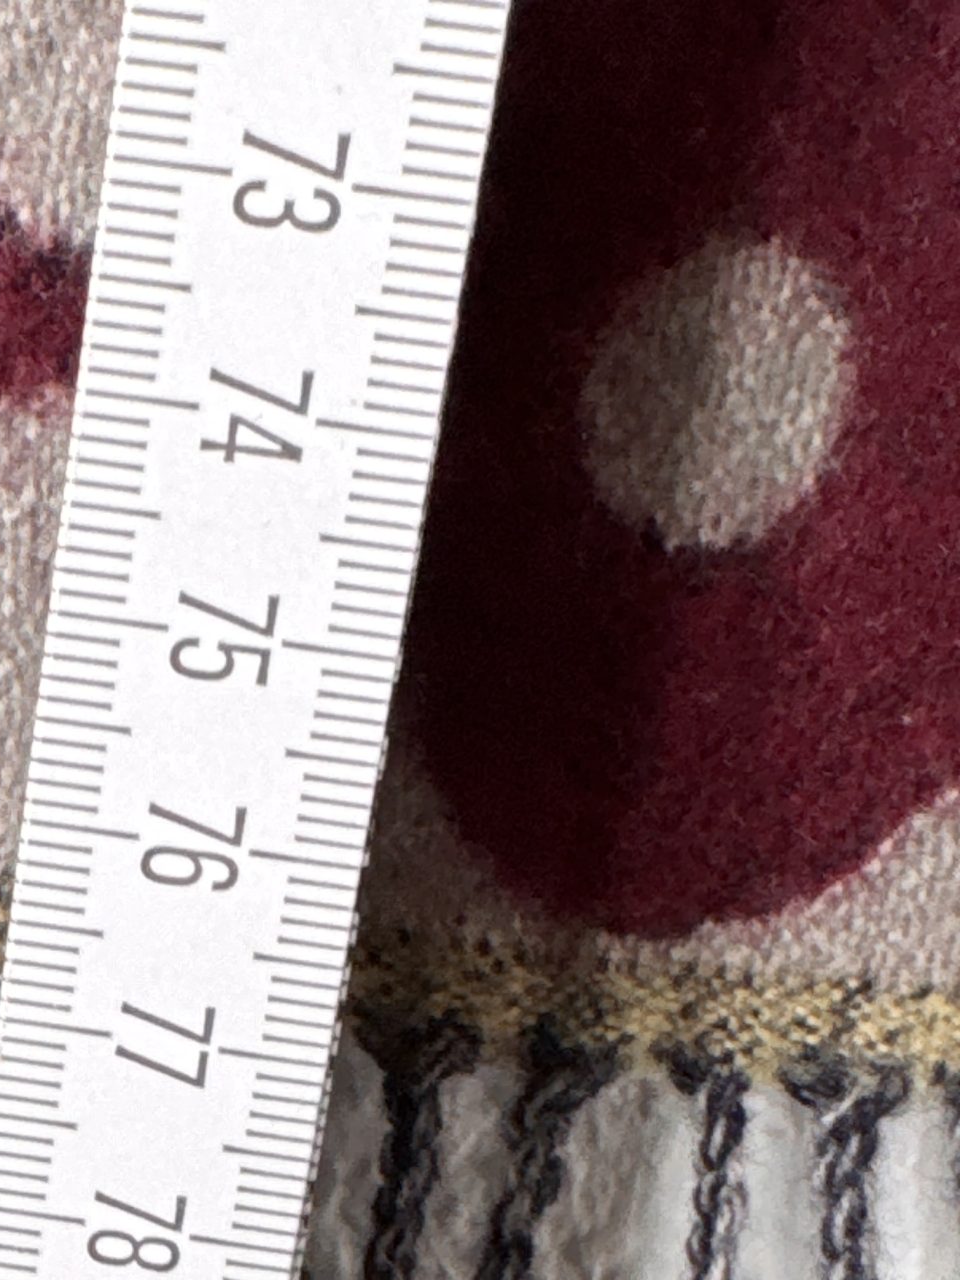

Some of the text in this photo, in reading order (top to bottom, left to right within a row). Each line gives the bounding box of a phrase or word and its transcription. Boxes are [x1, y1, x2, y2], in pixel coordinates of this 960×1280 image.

[232, 129, 351, 233] 73
[200, 368, 313, 463] 74
[169, 590, 280, 685] 75
[140, 802, 247, 891] 76
[114, 1001, 215, 1088] 77
[87, 1190, 187, 1273] 78
